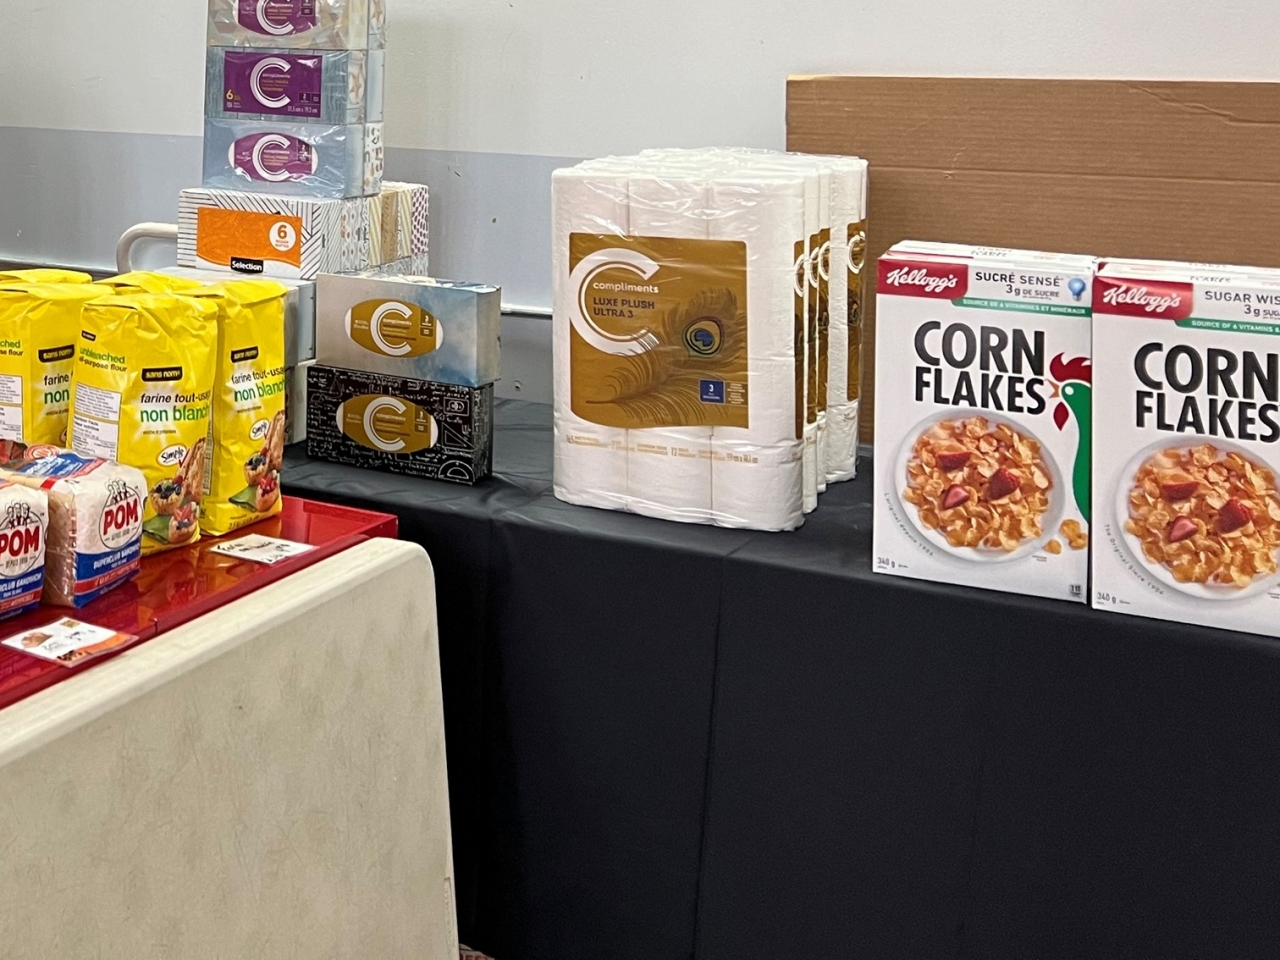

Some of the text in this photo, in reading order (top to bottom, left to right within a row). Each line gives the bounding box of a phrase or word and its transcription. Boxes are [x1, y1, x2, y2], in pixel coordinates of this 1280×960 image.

[226, 89, 234, 101] 6
[277, 224, 288, 239] 6
[231, 260, 263, 271] Selection
[886, 266, 958, 293] Kellogg's
[975, 271, 1061, 287] SUCRÉ SENSÉ
[592, 281, 659, 294] compliments
[1005, 284, 1013, 294] 3
[1014, 287, 1020, 296] g
[1034, 289, 1060, 298] SUCRE
[593, 297, 655, 309] LUXE PLUSH
[1103, 285, 1181, 313] Kellogg's
[1205, 290, 1280, 305] SUGAR WIS
[962, 299, 987, 307] SOURCE
[1005, 302, 1040, 311] VITAMINES
[1244, 304, 1261, 317] 3 g
[593, 308, 634, 318] ULTRA 3
[1191, 320, 1220, 329] SOURCE
[1238, 324, 1273, 333] VITAMINS
[8, 348, 24, 357] flour
[914, 320, 1045, 376] CORN
[79, 346, 125, 364] unbleached
[110, 363, 128, 373] flour
[1134, 342, 1279, 403] CORN
[44, 373, 69, 386] farine
[145, 371, 163, 379] sans
[231, 372, 252, 385] farine
[44, 389, 70, 404] non
[233, 389, 256, 402] non
[915, 366, 1046, 415] FLAKES
[140, 393, 172, 404] farine
[140, 409, 169, 423] non
[1136, 390, 1280, 443] FLAKES
[103, 498, 139, 536] POM
[877, 556, 890, 566] 340
[1110, 538, 1129, 565] Original
[1128, 564, 1146, 582] Since
[1096, 591, 1110, 602] 340
